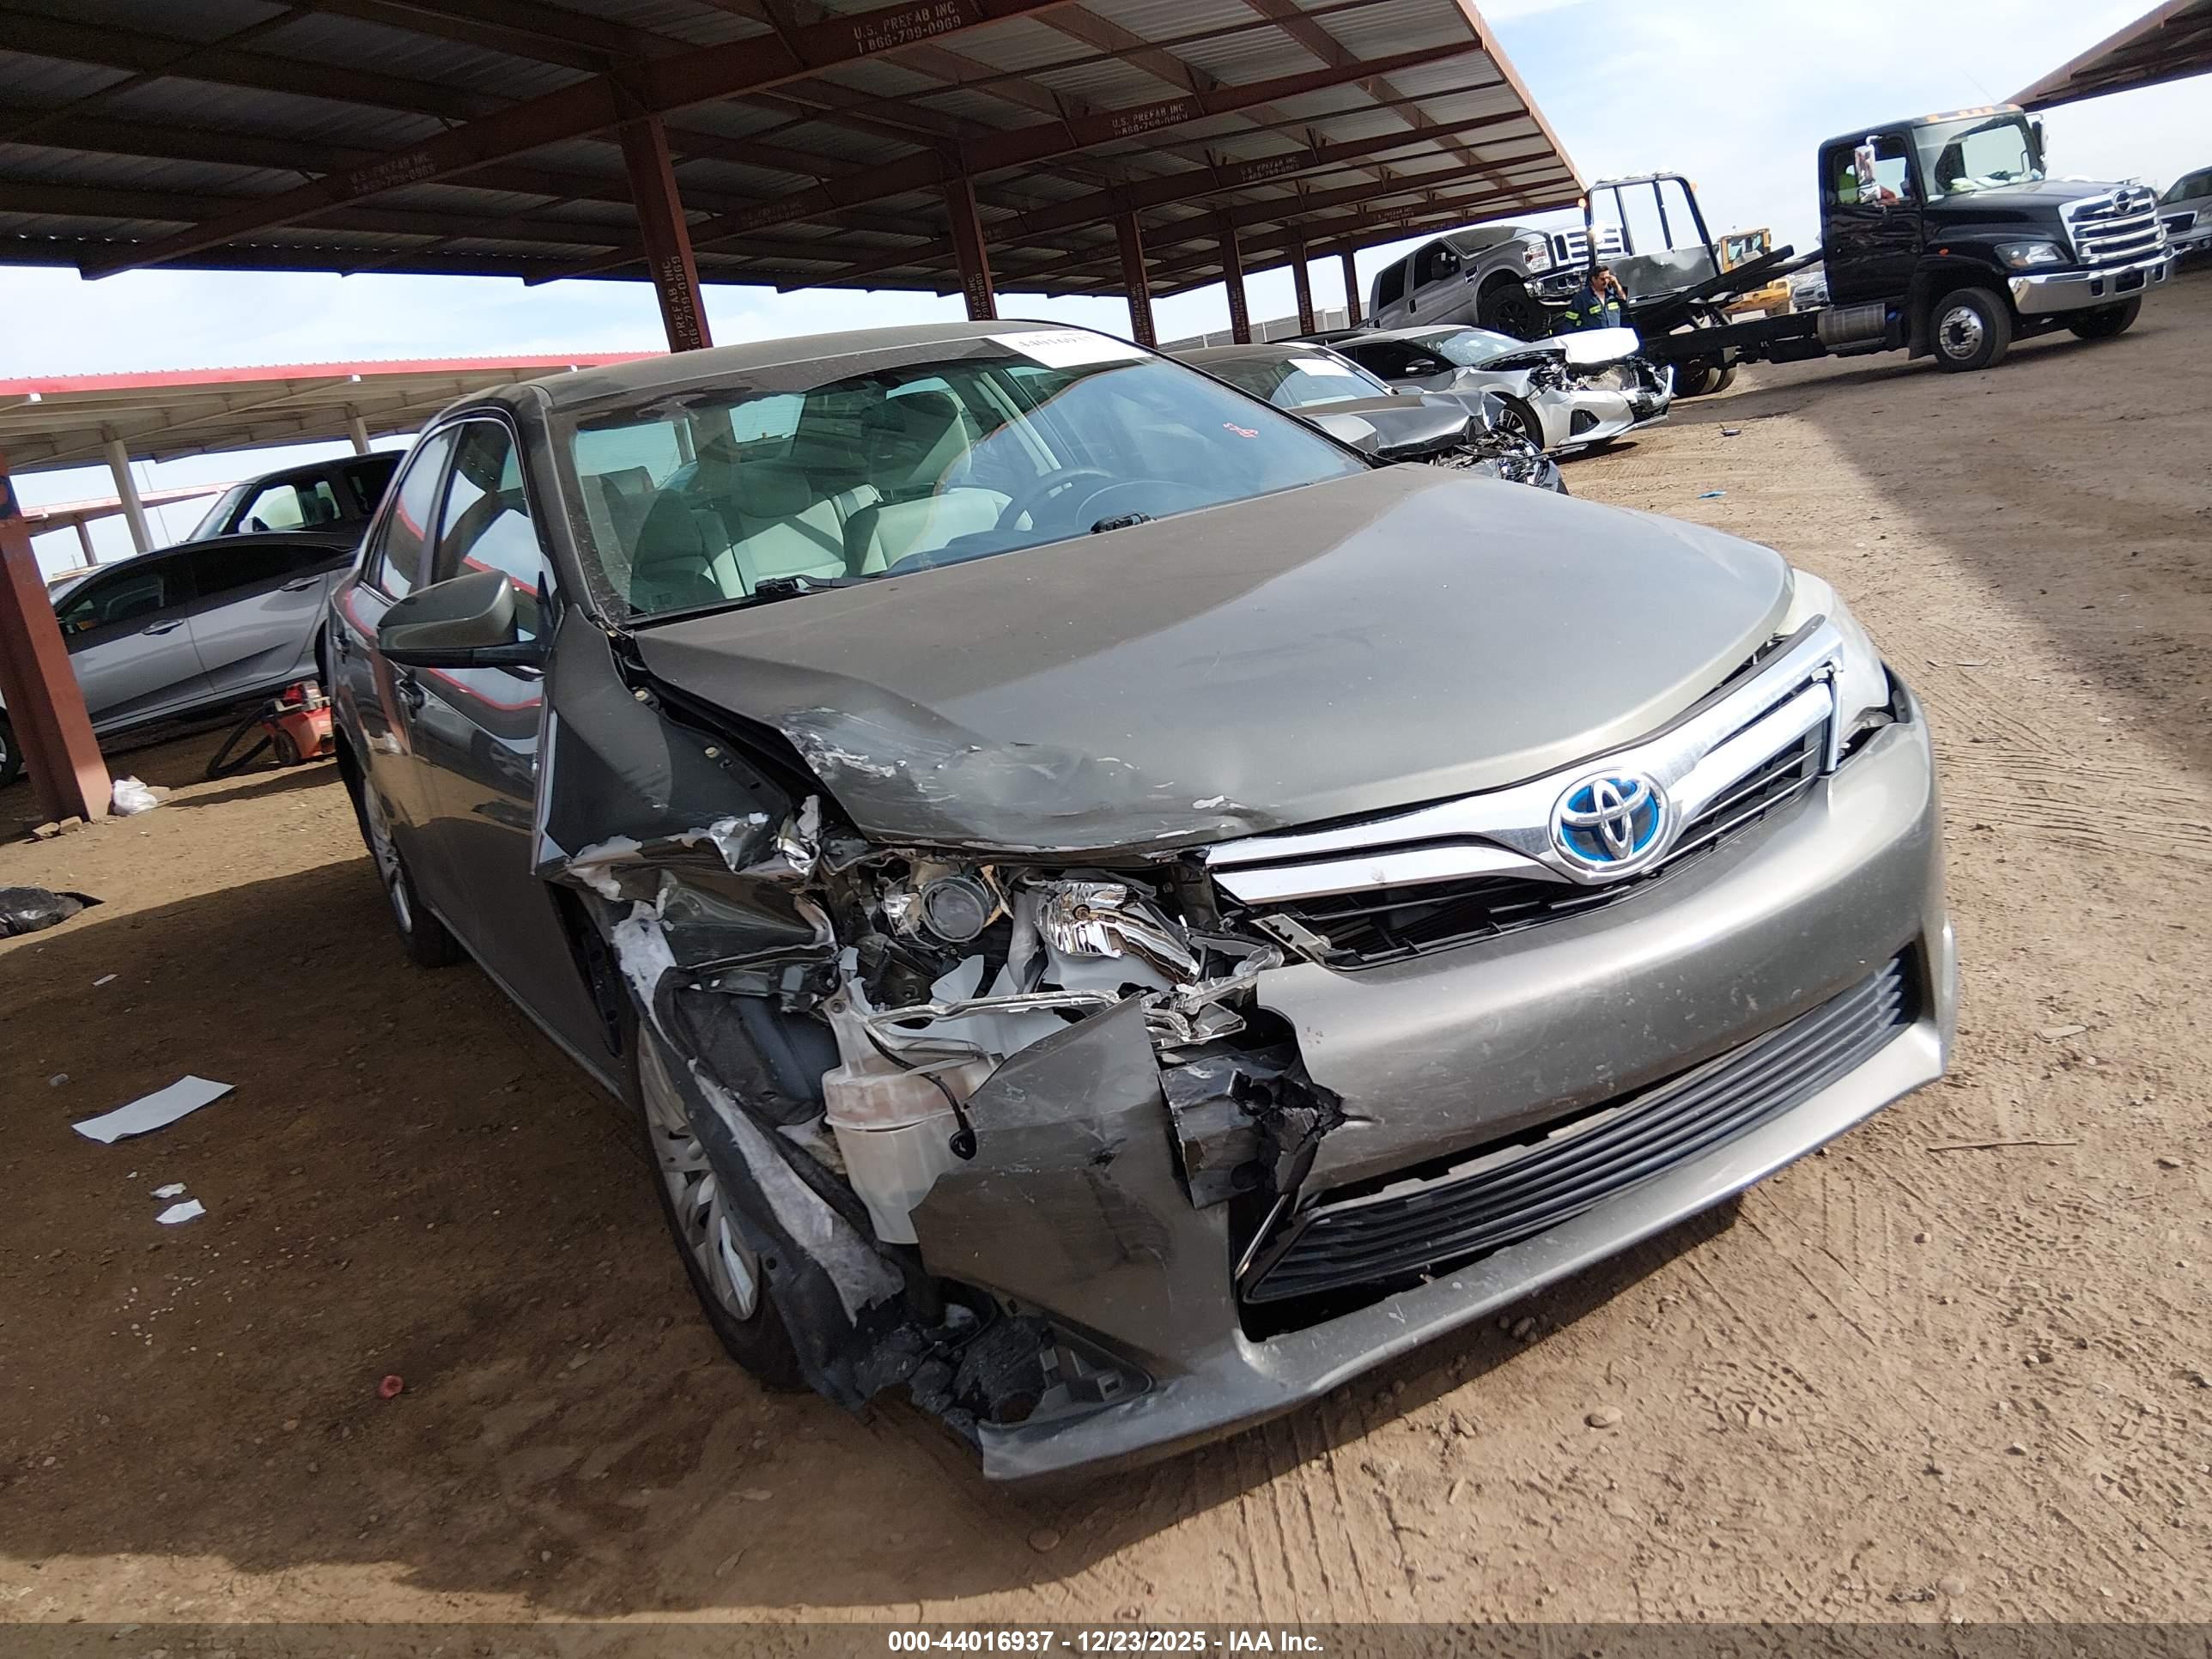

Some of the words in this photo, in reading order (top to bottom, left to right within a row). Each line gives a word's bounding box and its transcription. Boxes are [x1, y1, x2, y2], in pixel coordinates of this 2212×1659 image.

[854, 24, 878, 40] U.S.
[883, 8, 930, 32] PREFAB
[934, 1, 960, 17] INC.
[668, 288, 689, 337] PREFAB
[671, 255, 702, 349] 66-799-0969
